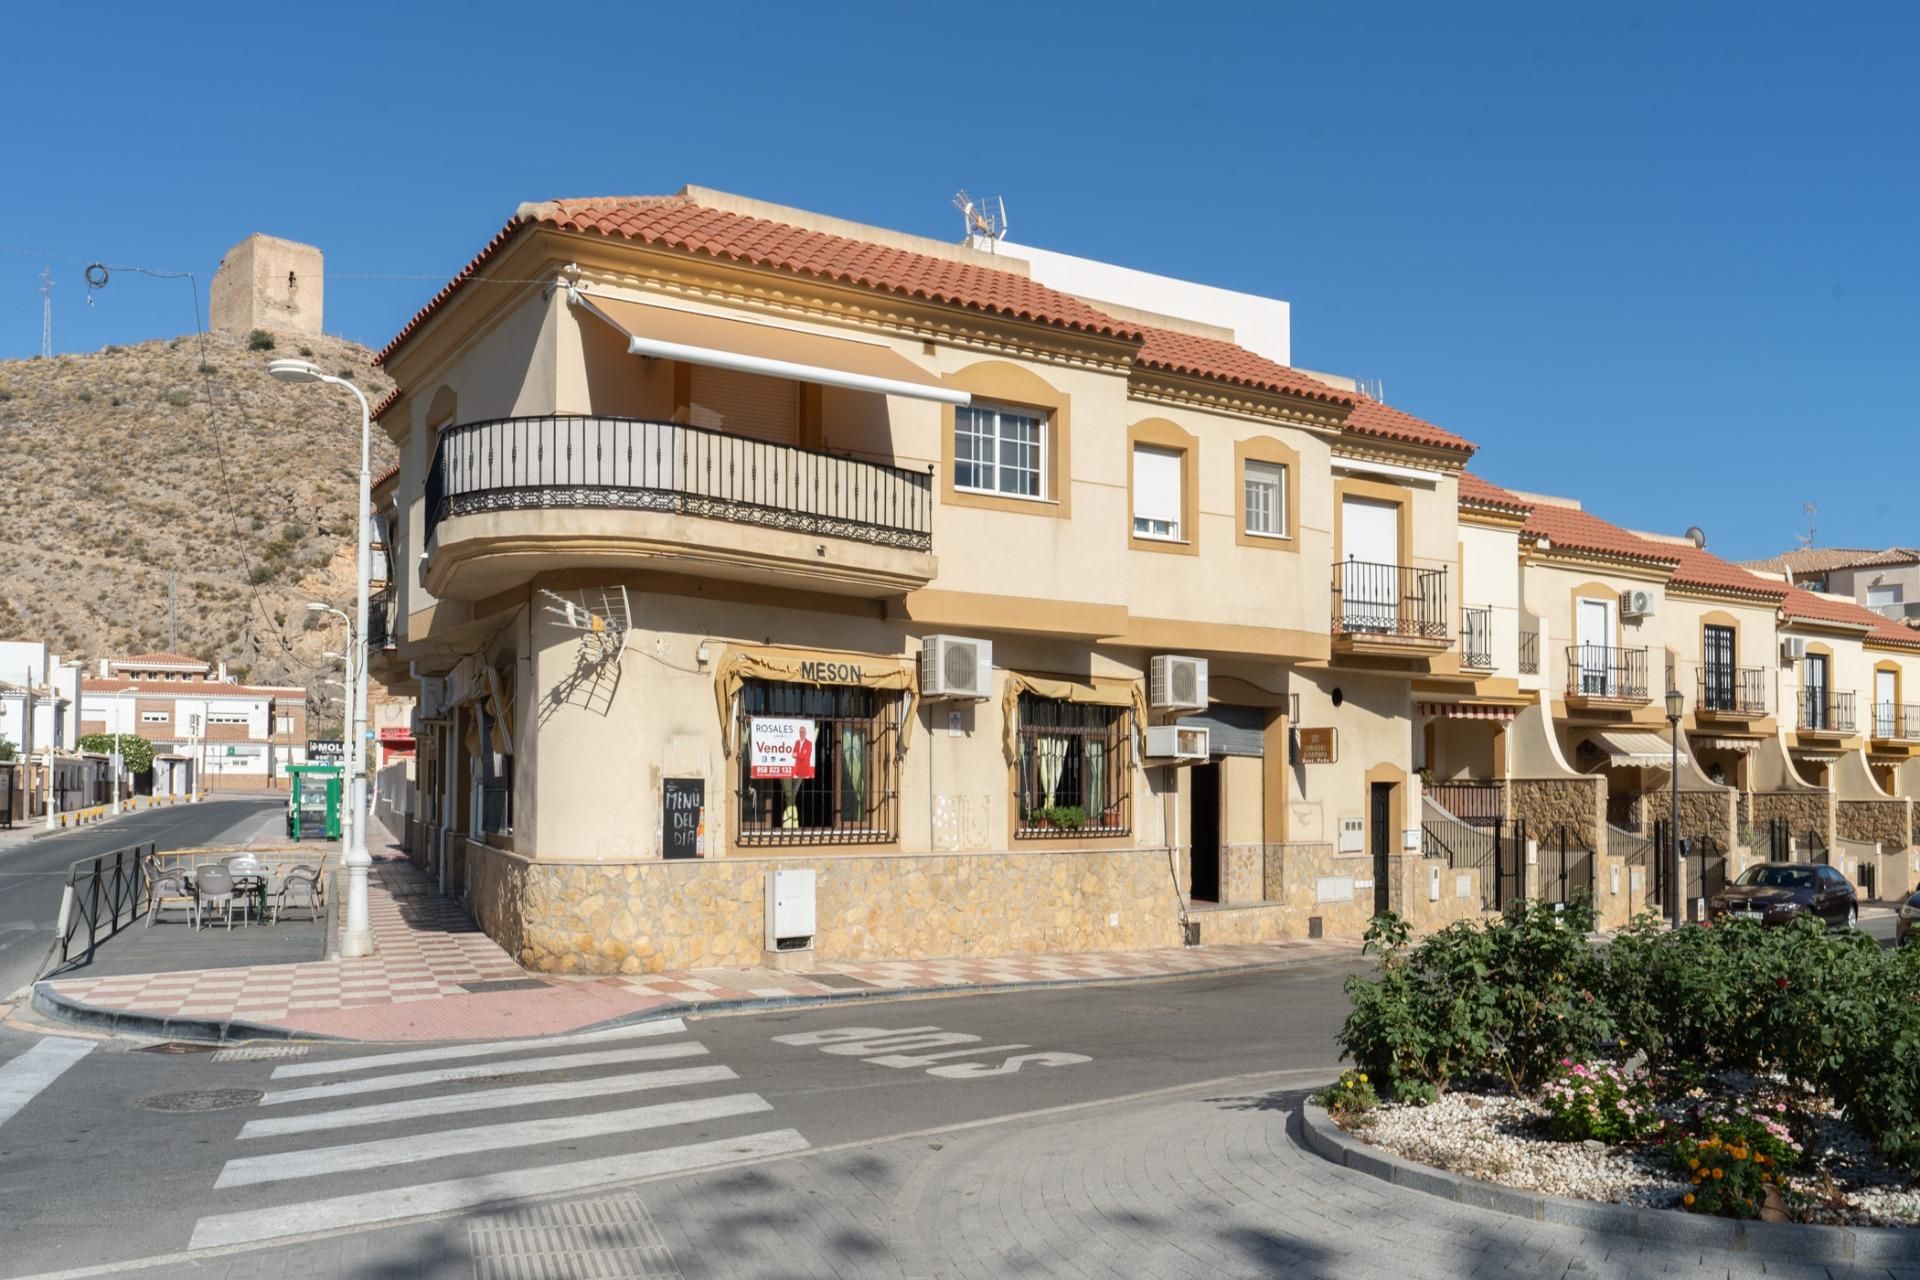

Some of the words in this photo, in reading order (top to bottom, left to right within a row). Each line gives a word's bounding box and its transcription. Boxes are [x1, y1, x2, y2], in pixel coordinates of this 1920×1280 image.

[801, 661, 862, 684] MESON
[756, 724, 793, 733] ROSALES
[756, 741, 792, 753] Vendo
[673, 812, 695, 829] DEL
[771, 1025, 1093, 1078] STOP
